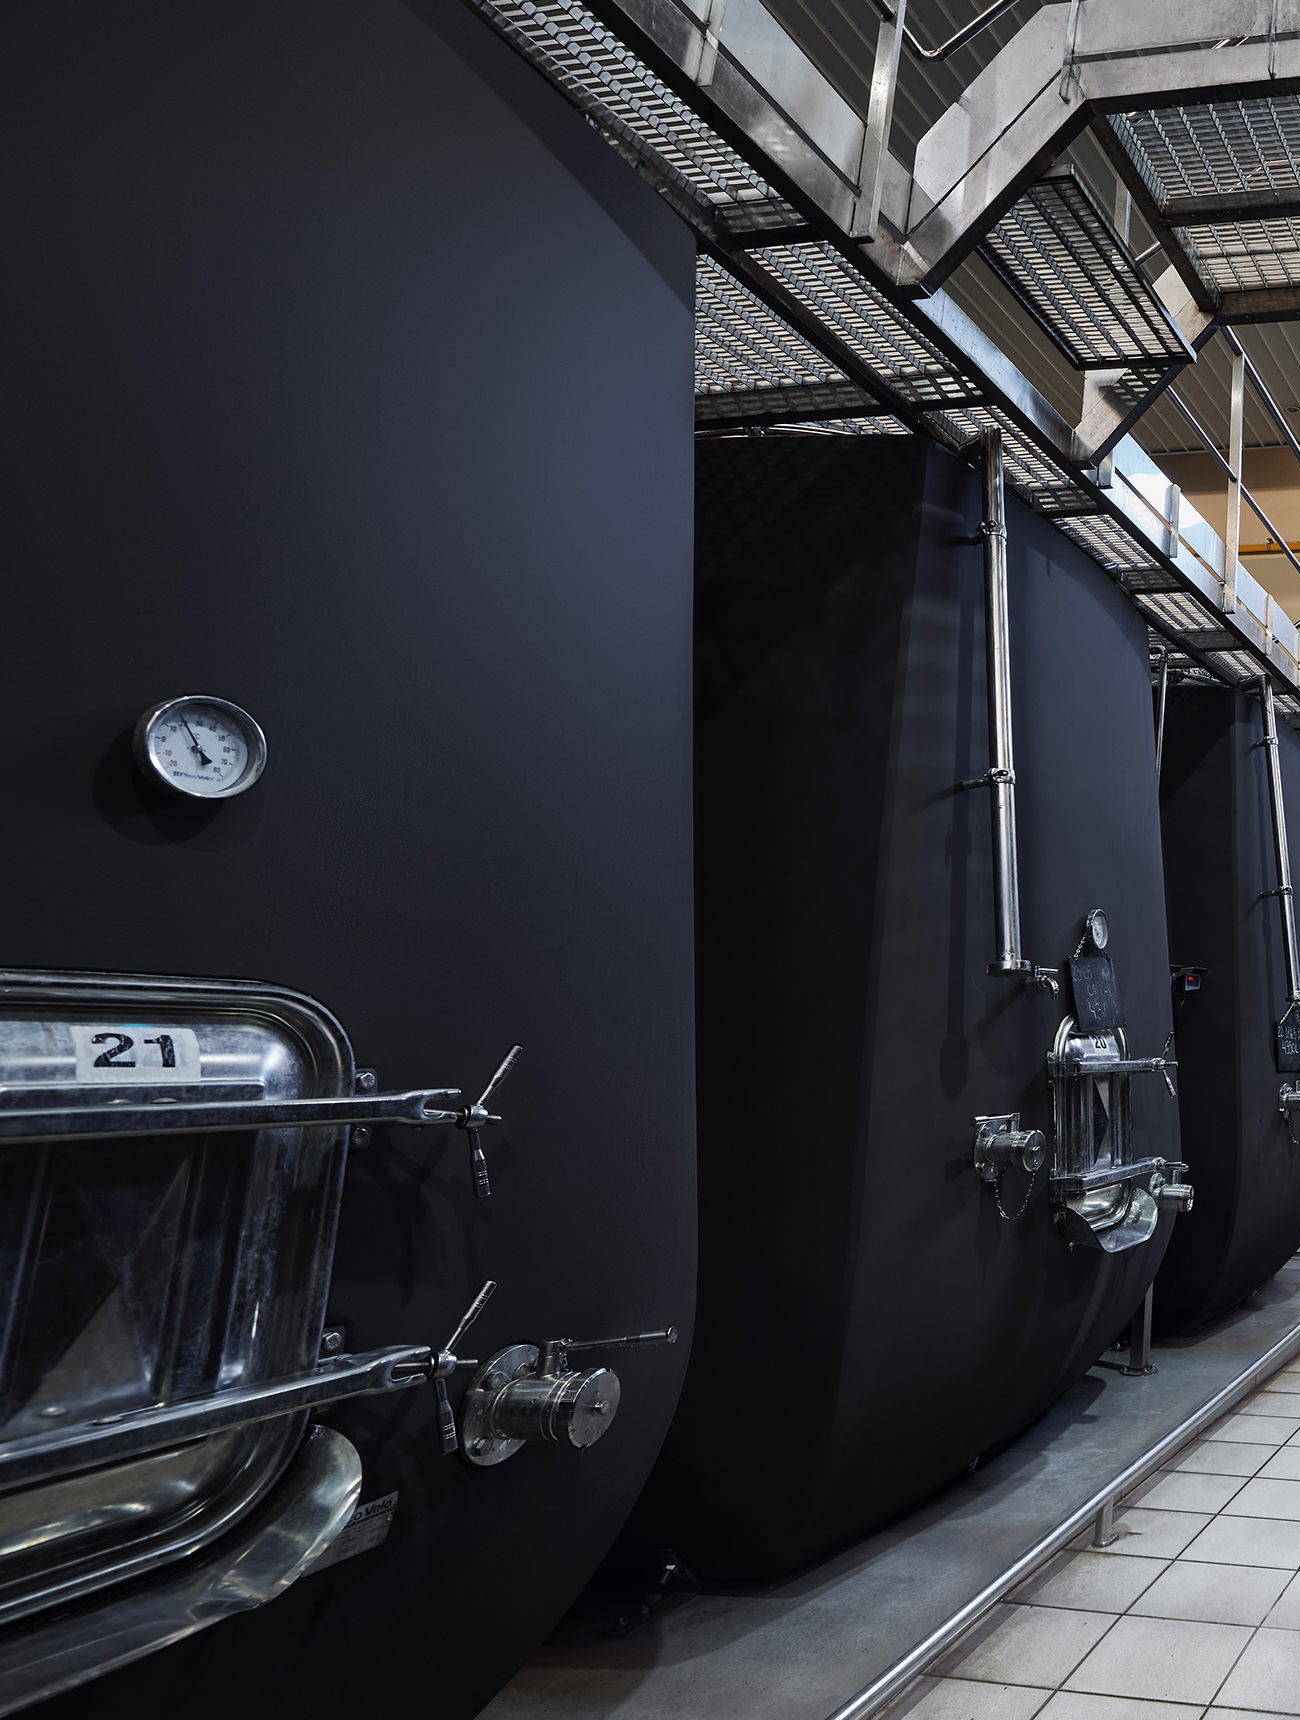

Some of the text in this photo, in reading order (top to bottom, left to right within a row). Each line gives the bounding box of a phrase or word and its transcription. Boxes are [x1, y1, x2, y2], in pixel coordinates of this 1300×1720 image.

[91, 1032, 176, 1068] 21
[1092, 1036, 1107, 1049] 20
[365, 1499, 393, 1516] Velo
